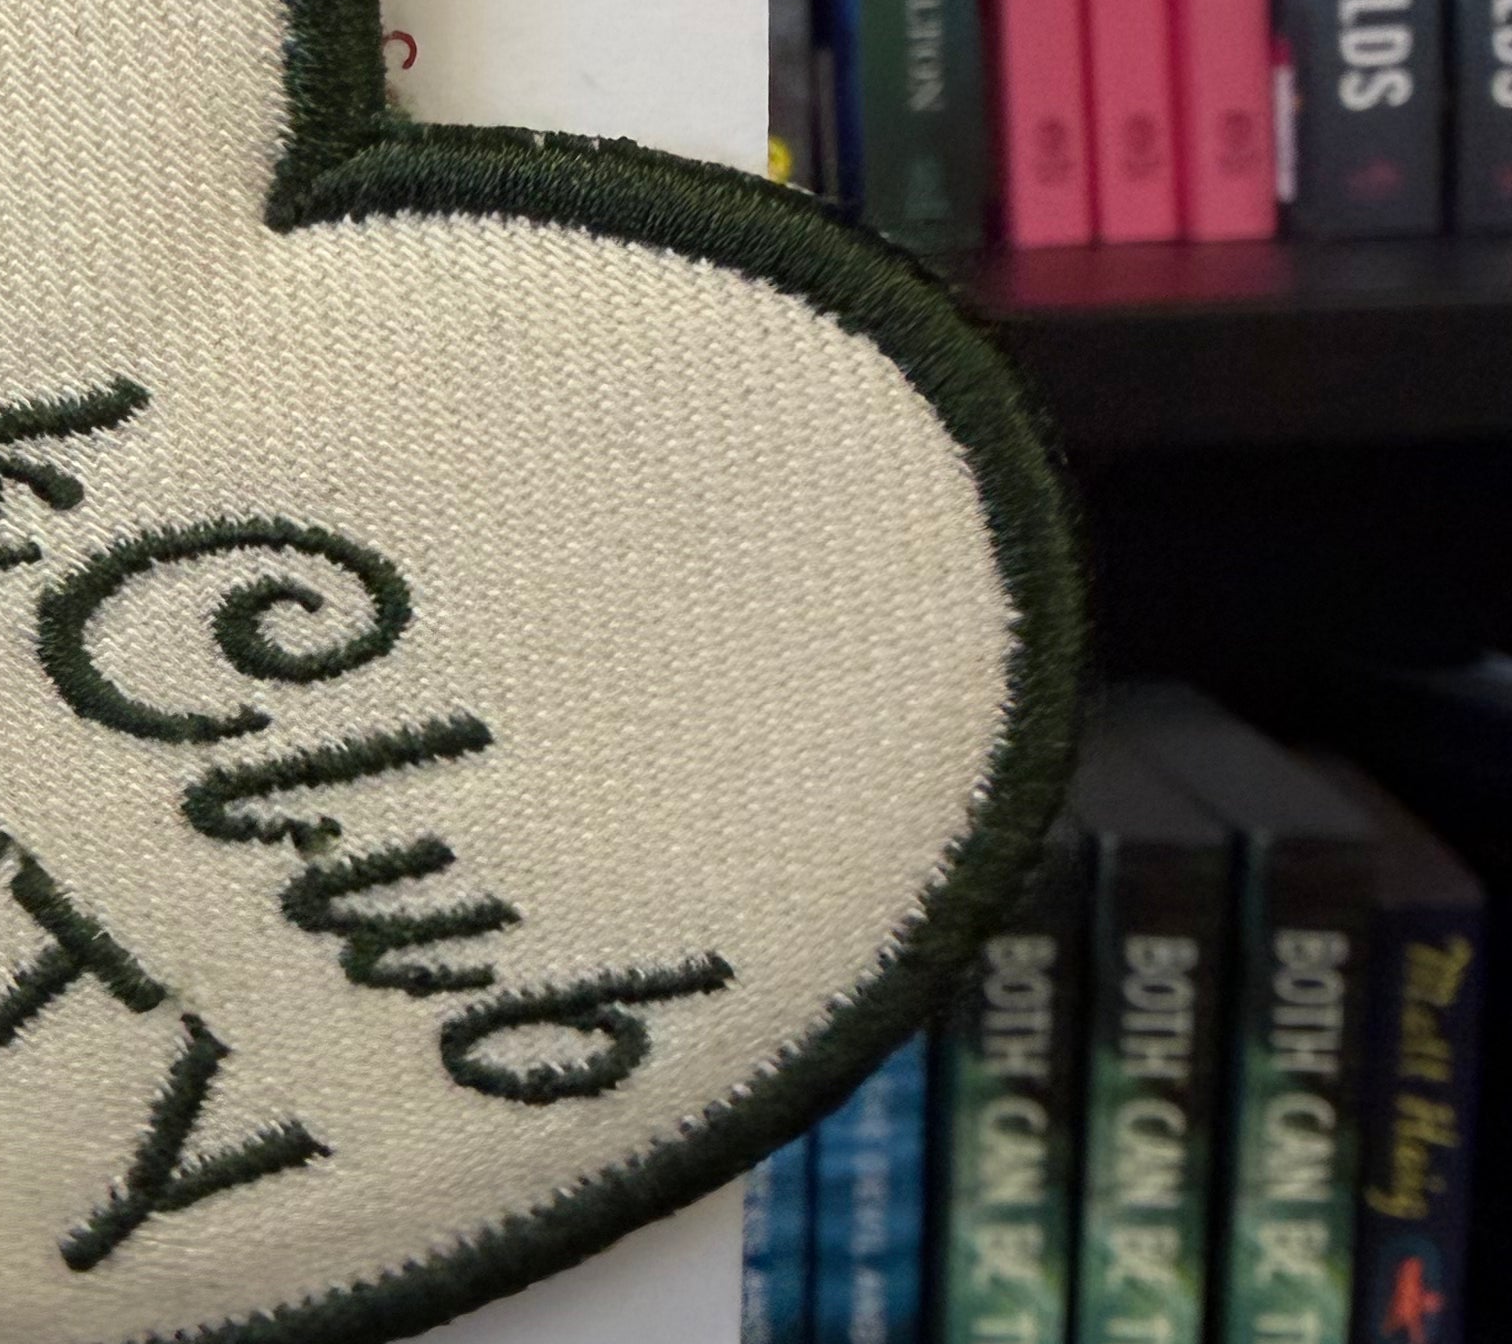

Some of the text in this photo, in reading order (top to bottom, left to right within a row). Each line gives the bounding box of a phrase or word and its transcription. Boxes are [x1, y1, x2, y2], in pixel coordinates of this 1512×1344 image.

[37, 517, 736, 1104] Club
[982, 934, 1057, 1080] BOTH
[1120, 934, 1200, 1081] BOTH
[1269, 928, 1351, 1076] BOTH
[978, 1094, 1050, 1205] CAN
[1113, 1096, 1188, 1208] CAN
[1263, 1090, 1338, 1202] CAN
